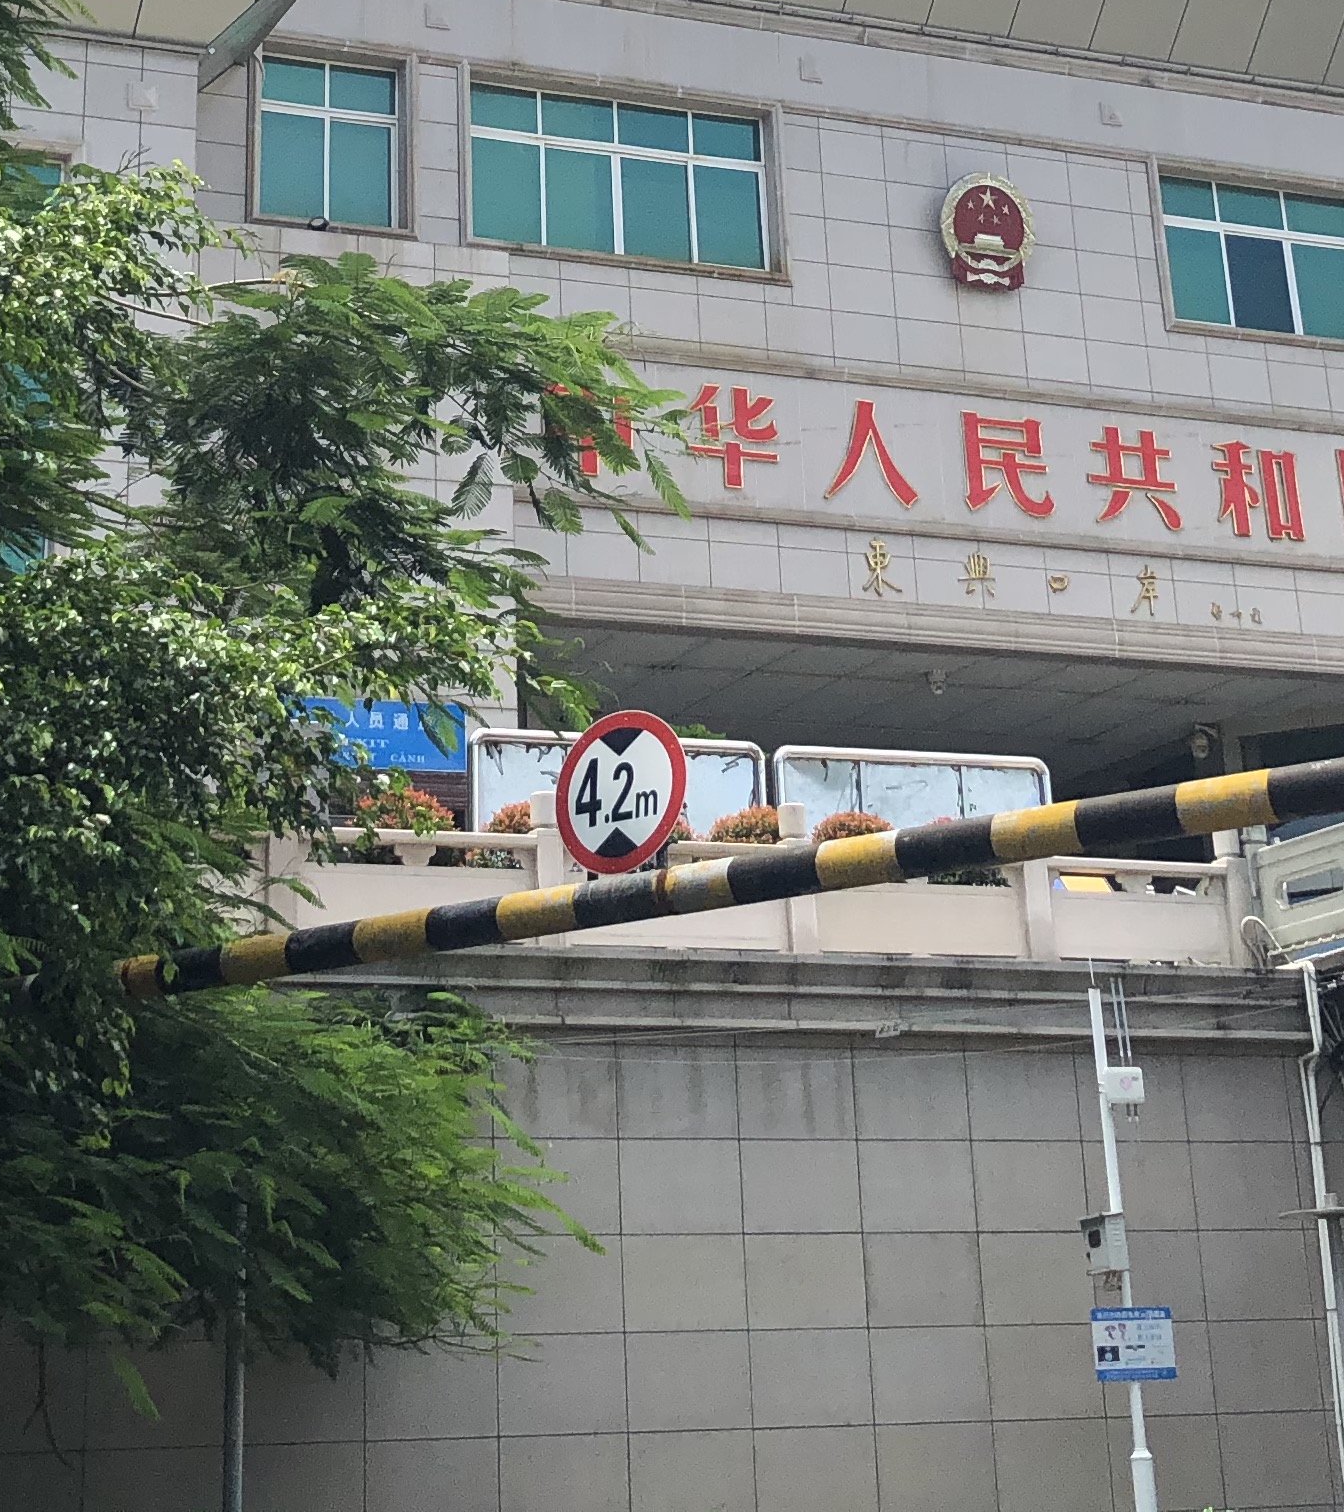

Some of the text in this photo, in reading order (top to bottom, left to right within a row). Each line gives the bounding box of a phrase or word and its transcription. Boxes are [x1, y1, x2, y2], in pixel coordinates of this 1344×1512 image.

[345, 710, 425, 731] 人员通
[575, 757, 658, 828] 4.2m
